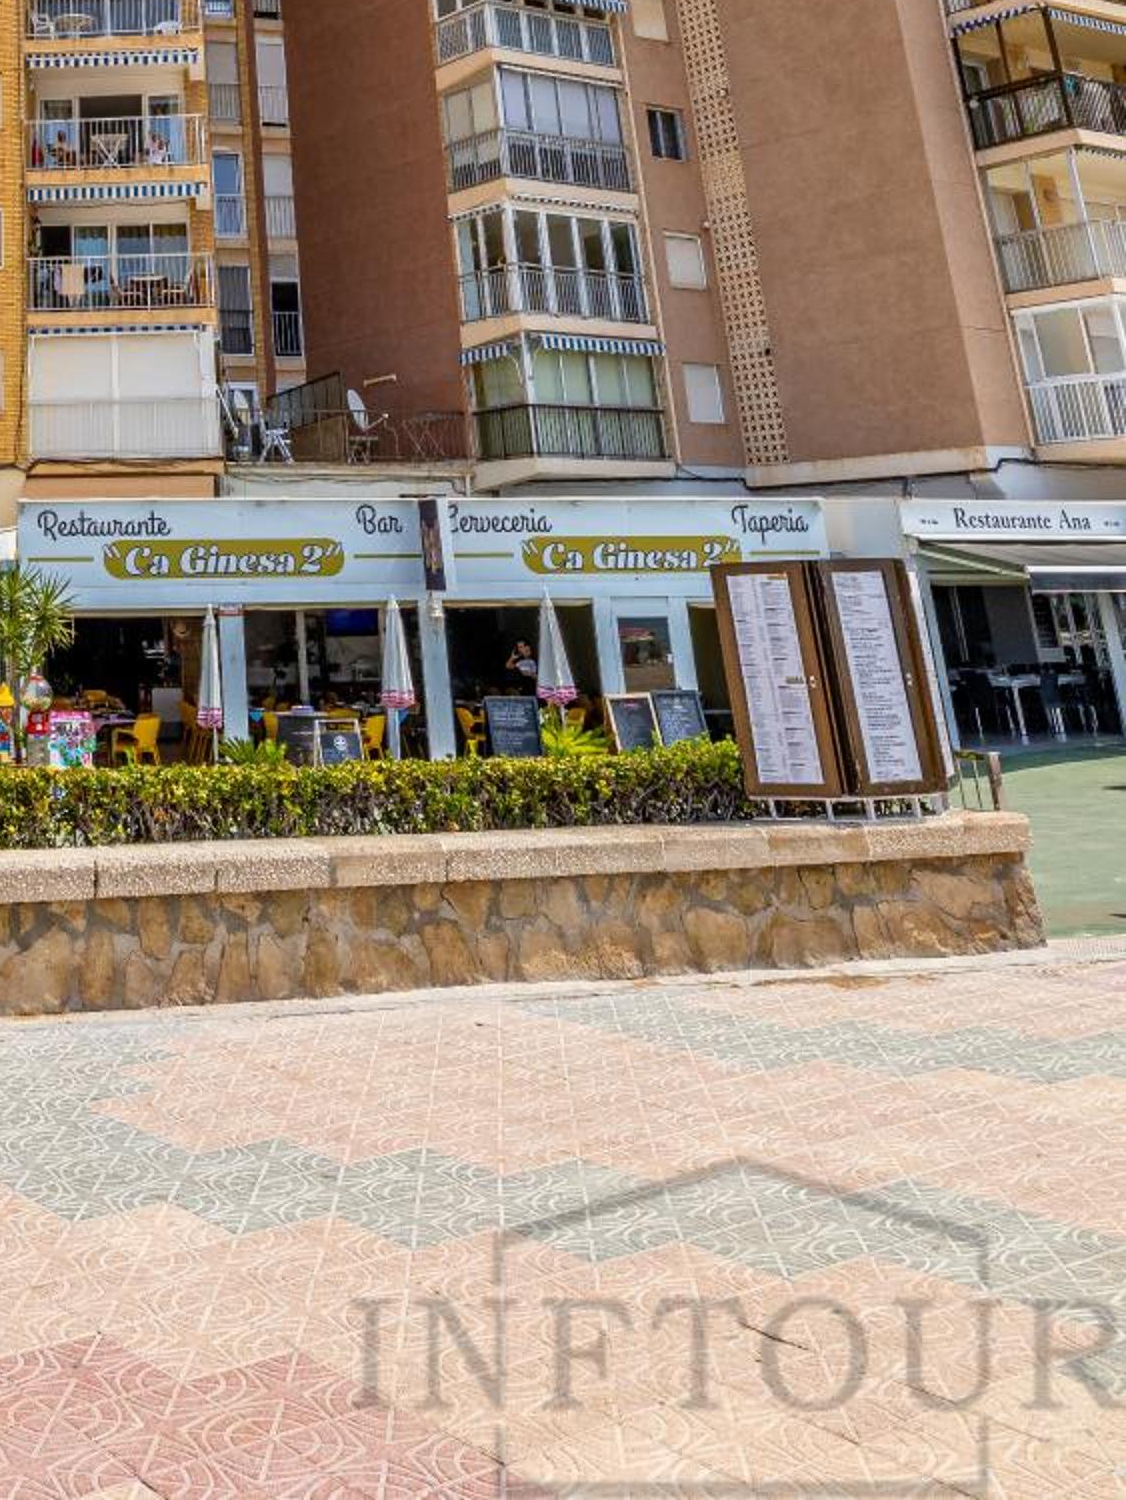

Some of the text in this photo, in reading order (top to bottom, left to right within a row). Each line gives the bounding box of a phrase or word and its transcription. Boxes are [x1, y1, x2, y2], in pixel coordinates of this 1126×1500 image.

[37, 504, 403, 541] Restaurante Bar
[731, 504, 810, 546] Taperia
[953, 507, 1092, 531] Restaurante Ana
[179, 544, 297, 577] Ginesa
[592, 542, 699, 572] Ginesa
